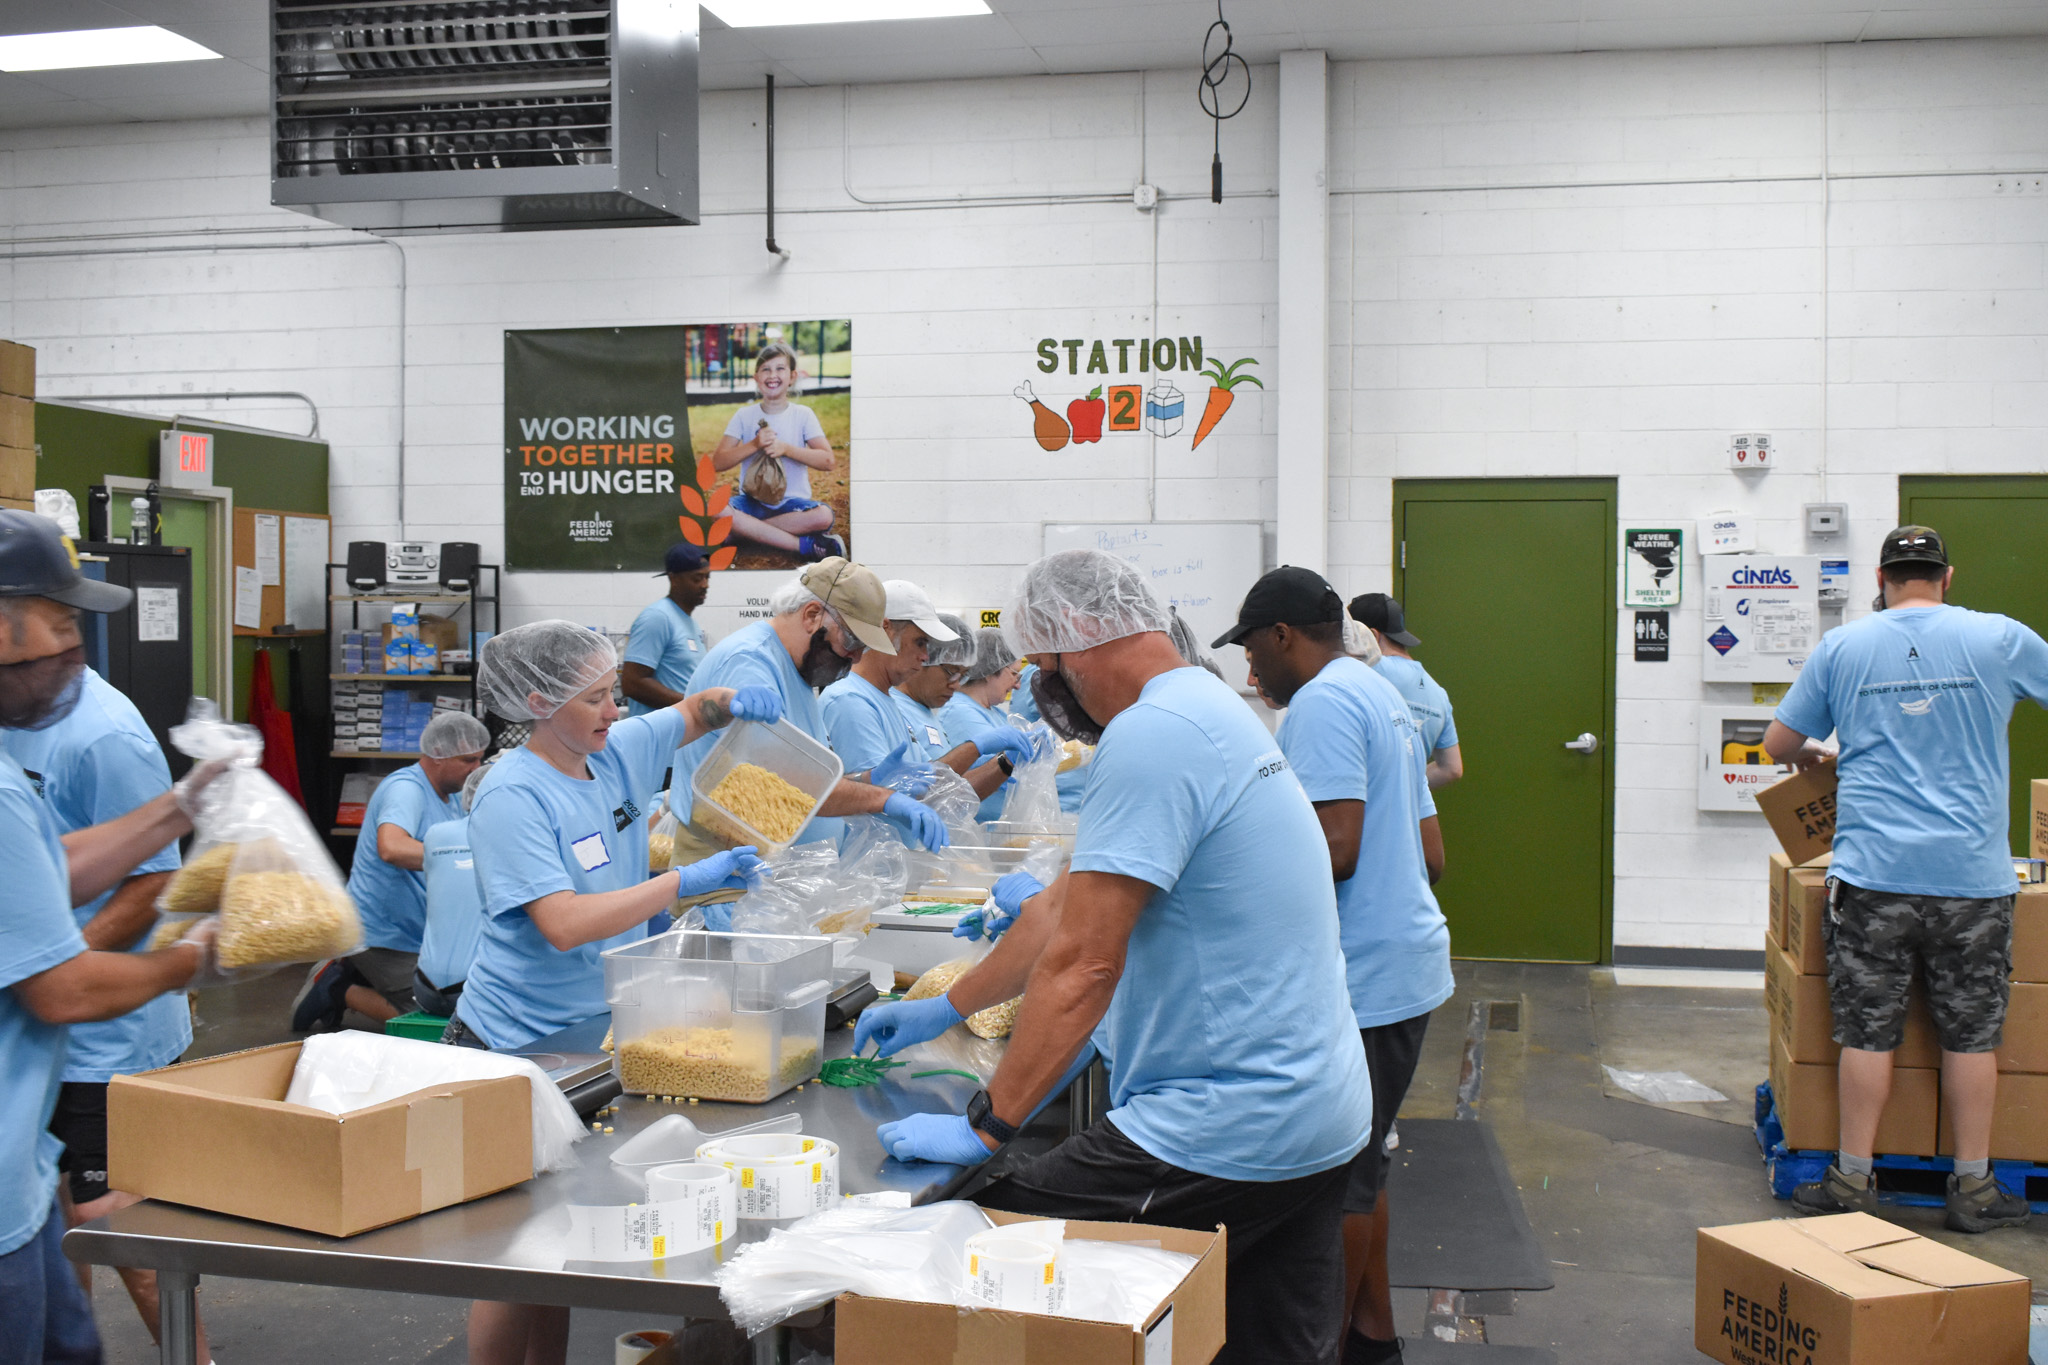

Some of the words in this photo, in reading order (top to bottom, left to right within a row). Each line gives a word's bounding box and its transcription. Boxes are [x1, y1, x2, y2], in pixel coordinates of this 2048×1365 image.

[1037, 336, 1203, 375] STATION
[1113, 390, 1135, 425] 2
[519, 415, 675, 441] WORKING
[180, 434, 208, 472] EXIT
[519, 443, 674, 466] TOGETHER
[520, 472, 544, 486] TO
[549, 469, 675, 495] HUNGER
[521, 486, 544, 496] END
[569, 528, 613, 536] AMERICA
[570, 520, 613, 528] FEEDING
[1637, 533, 1670, 541] SEVERE
[739, 610, 760, 618] HAND
[1908, 646, 1920, 659] A
[1858, 690, 1870, 698] TO
[1870, 686, 1892, 696] START
[1893, 685, 1900, 693] A
[1901, 683, 1926, 692] RIPPLE
[1928, 682, 1939, 691] OF
[1258, 766, 1270, 779] TO
[1736, 774, 1758, 784] AED
[622, 798, 641, 818] 2023
[1723, 1288, 1816, 1352] FEEDING
[1731, 1345, 1756, 1365] West
